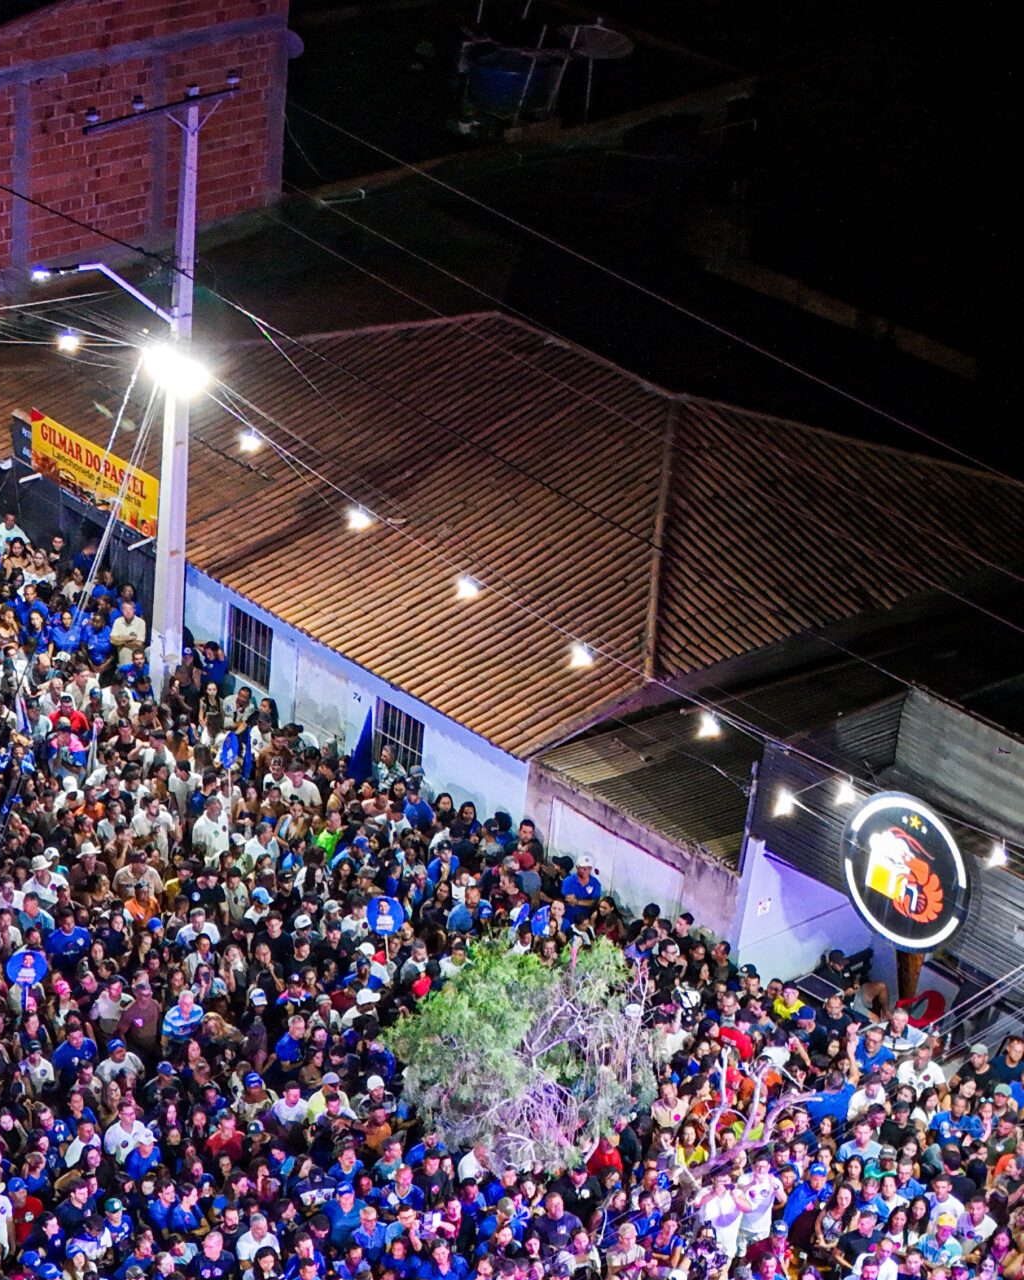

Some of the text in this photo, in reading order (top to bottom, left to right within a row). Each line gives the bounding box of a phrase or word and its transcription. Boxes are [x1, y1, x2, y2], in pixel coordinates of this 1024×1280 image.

[41, 423, 146, 499] GILMAR DO PASTEL
[102, 480, 142, 508] pastaria
